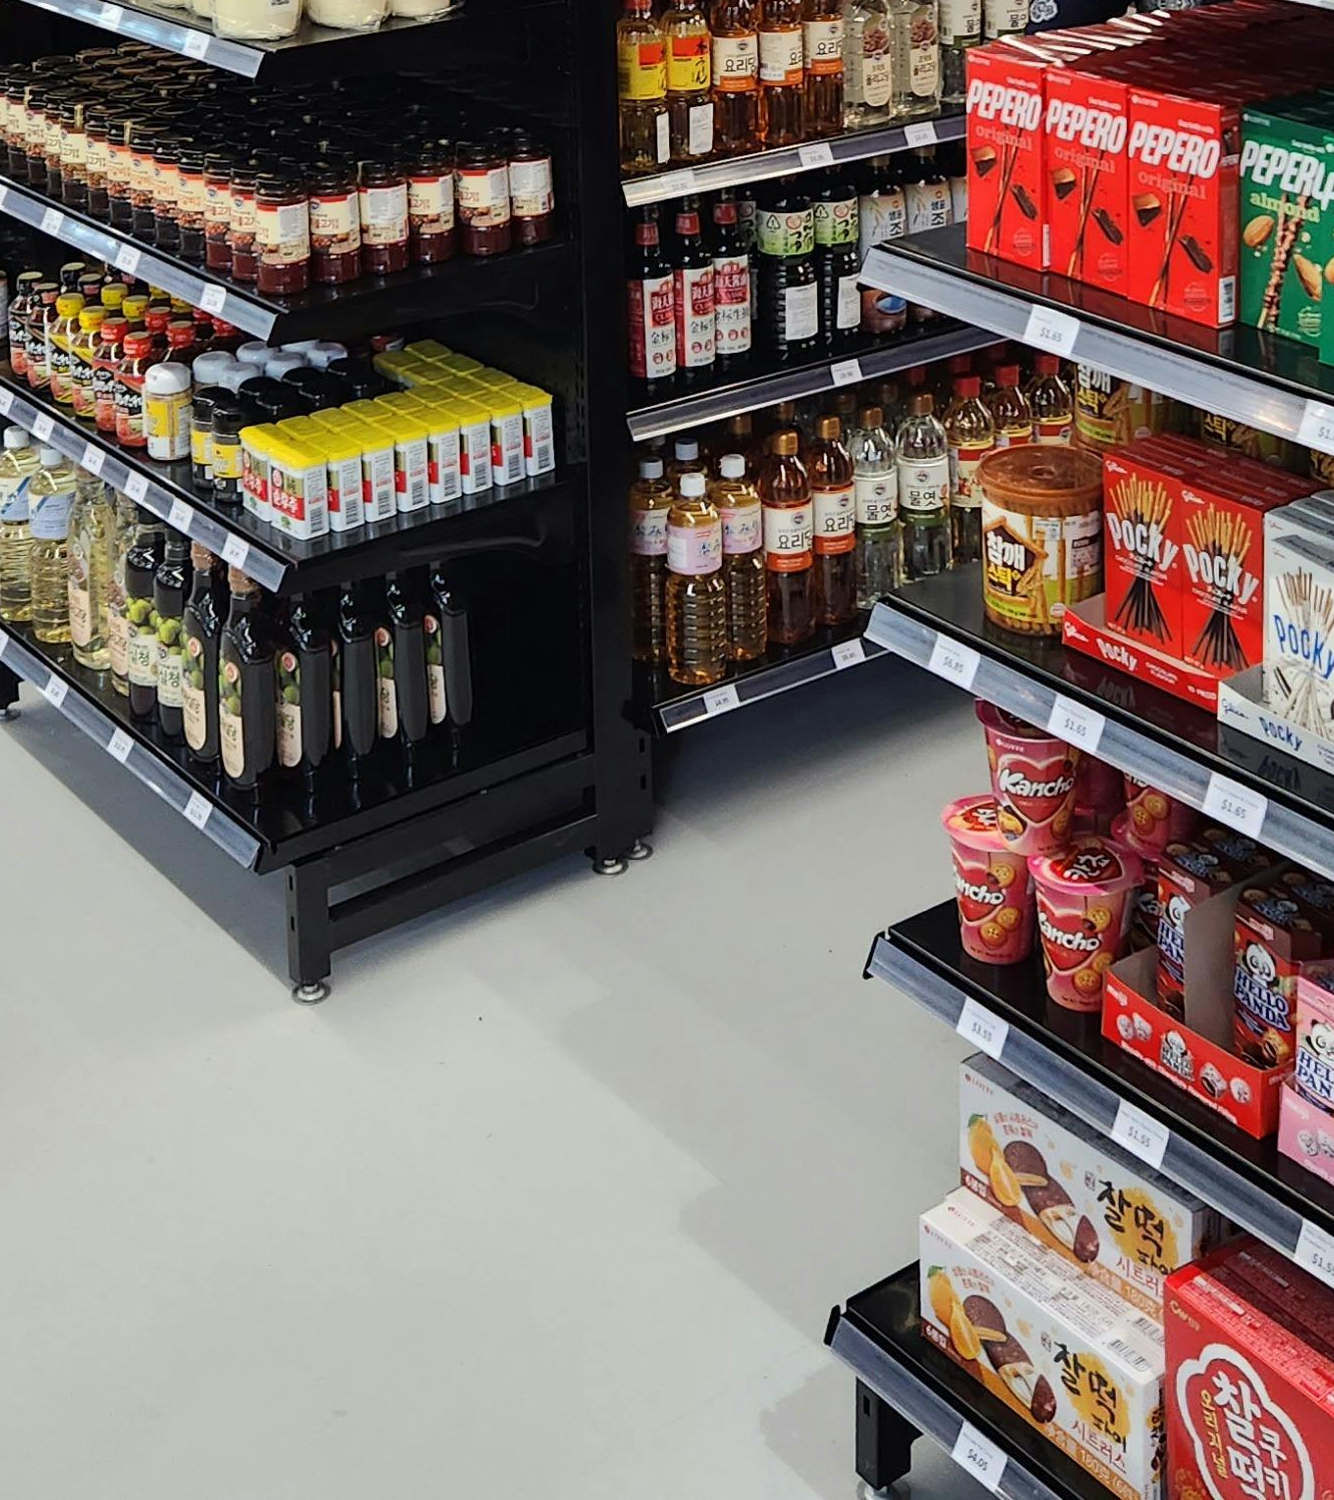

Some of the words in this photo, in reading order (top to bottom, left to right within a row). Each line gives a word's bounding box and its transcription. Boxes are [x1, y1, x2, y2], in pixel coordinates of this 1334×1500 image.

[966, 78, 1043, 132] PEPERO
[975, 124, 1033, 152] original
[1045, 98, 1128, 155] PEPERO
[1054, 146, 1116, 174] original
[1128, 120, 1221, 180] PEPERO
[1138, 169, 1206, 199] original
[1249, 190, 1321, 224] almond
[1037, 324, 1065, 346] $1.65
[986, 529, 1026, 571] 참깨
[986, 562, 1019, 592] 스틱
[1064, 718, 1088, 738] $1.65
[998, 767, 1076, 799] Kancho
[1220, 799, 1248, 820] $1.65
[953, 876, 1006, 905] ancho
[1234, 967, 1290, 1015] HELLO
[1234, 986, 1291, 1034] PANDA
[1127, 1125, 1152, 1149] $1.55
[1097, 1178, 1165, 1258] 찰떡
[1115, 1256, 1164, 1297] 시트러
[1053, 1340, 1117, 1425] 찰떡
[1071, 1419, 1128, 1475] 시트러스
[1093, 1413, 1128, 1454] 파이
